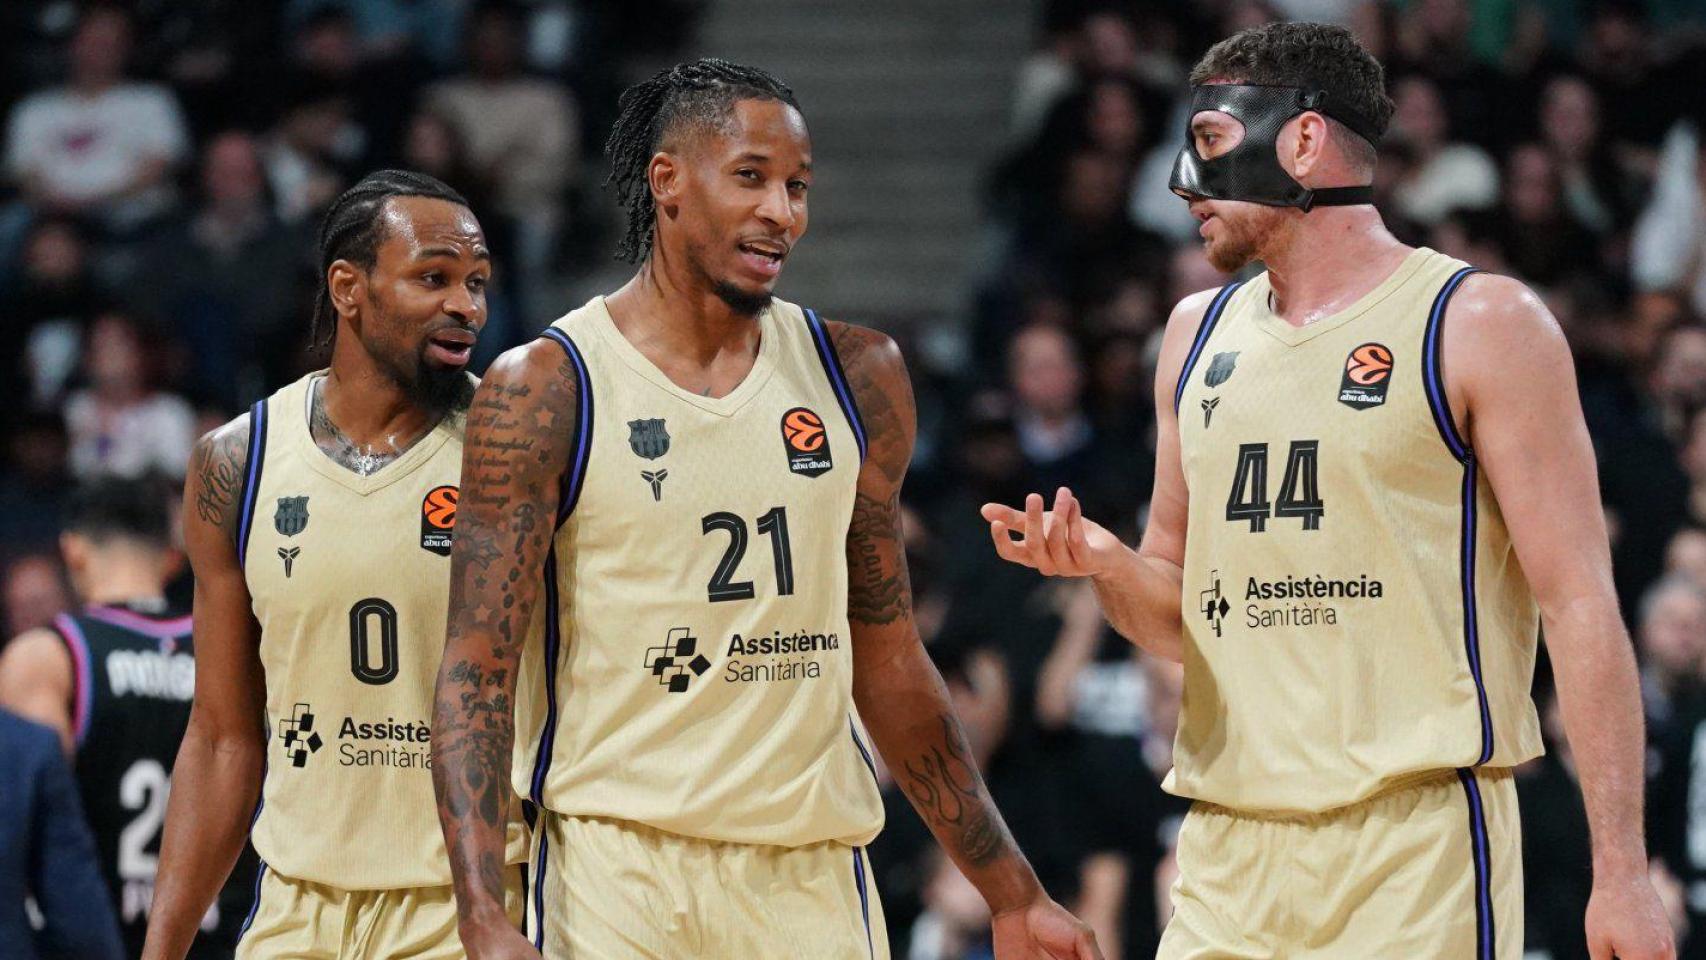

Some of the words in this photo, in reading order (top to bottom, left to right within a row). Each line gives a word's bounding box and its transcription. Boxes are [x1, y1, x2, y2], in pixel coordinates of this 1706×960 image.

[1226, 440, 1324, 533] 44
[423, 539, 440, 547] abu
[701, 506, 794, 602] 21
[1245, 575, 1383, 600] Assistència
[1246, 602, 1337, 628] Sanitària
[349, 597, 399, 685] 0
[724, 656, 820, 682] Sanitària
[338, 717, 431, 743] Assistè
[339, 742, 432, 770] Sanitària
